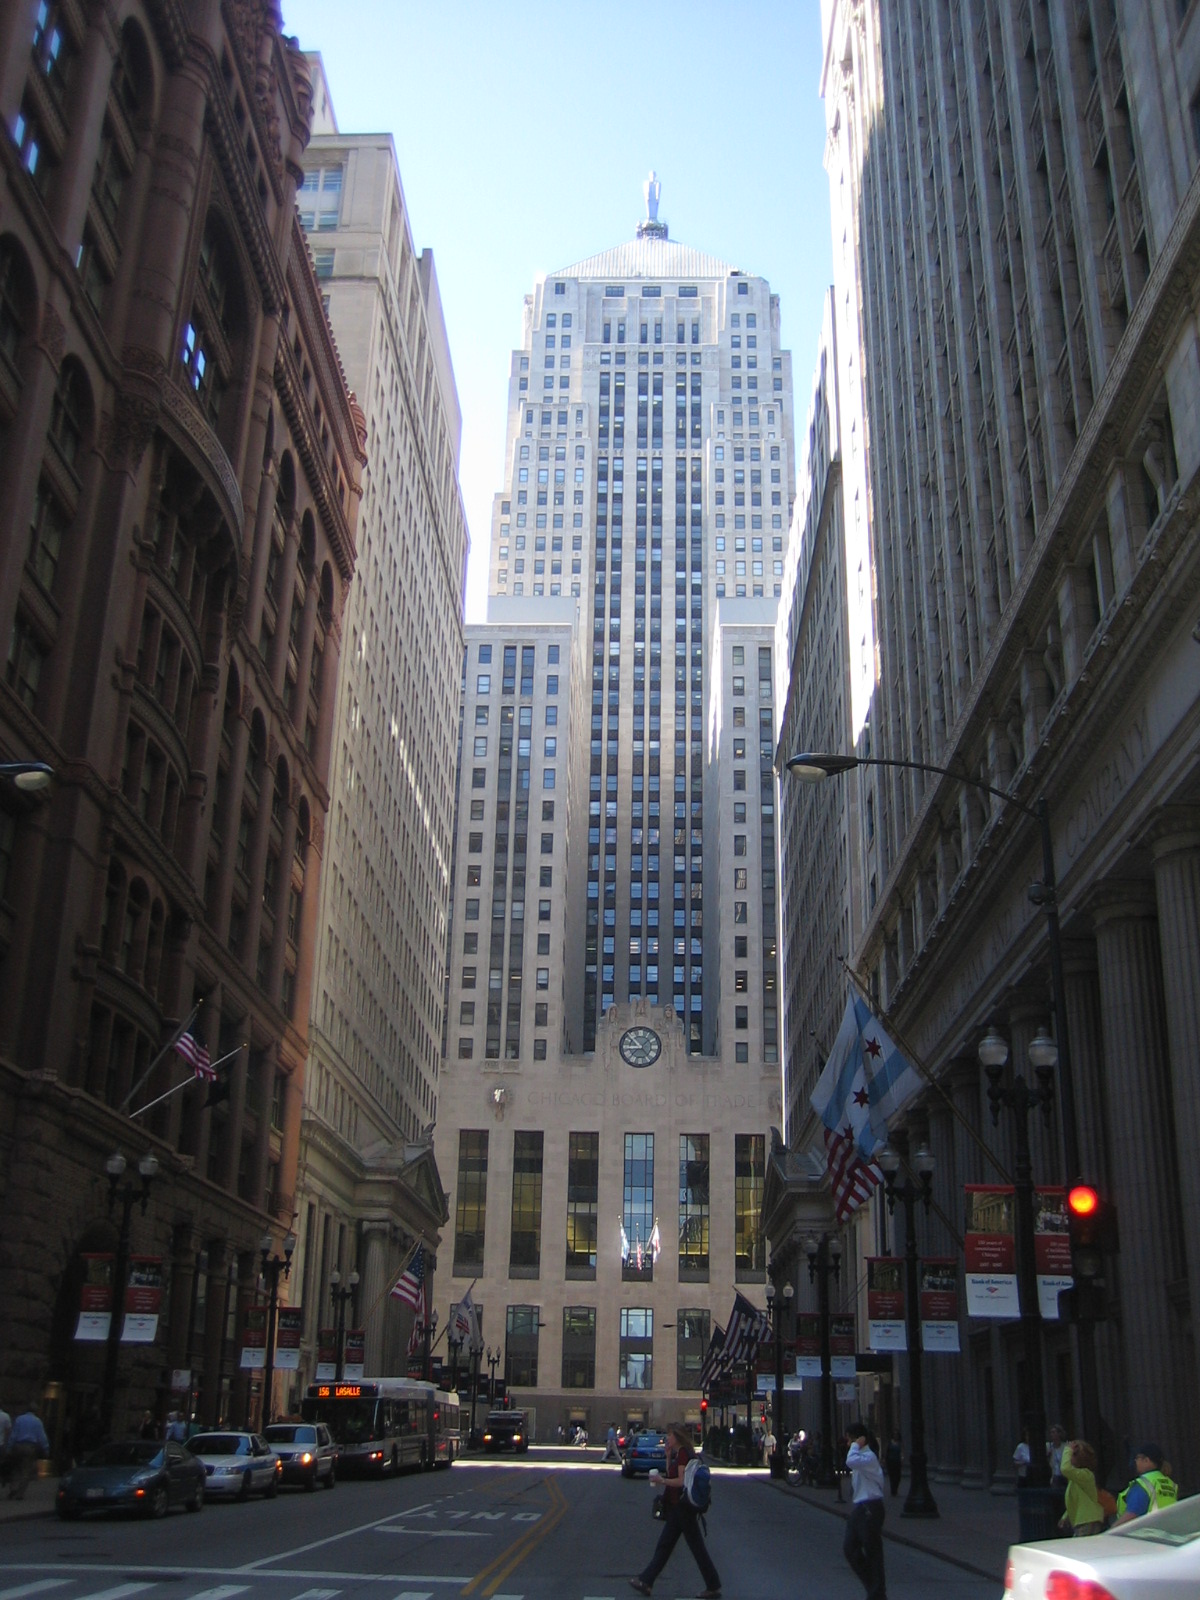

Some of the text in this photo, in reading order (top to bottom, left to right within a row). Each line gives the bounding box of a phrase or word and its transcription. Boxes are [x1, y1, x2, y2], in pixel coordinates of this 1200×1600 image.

[1065, 706, 1149, 859] COMPANY
[527, 1090, 756, 1108] CHICAGO BOARD OF TRADE
[318, 1386, 361, 1397] 156 LASALLE
[404, 1509, 542, 1521] ONLY
